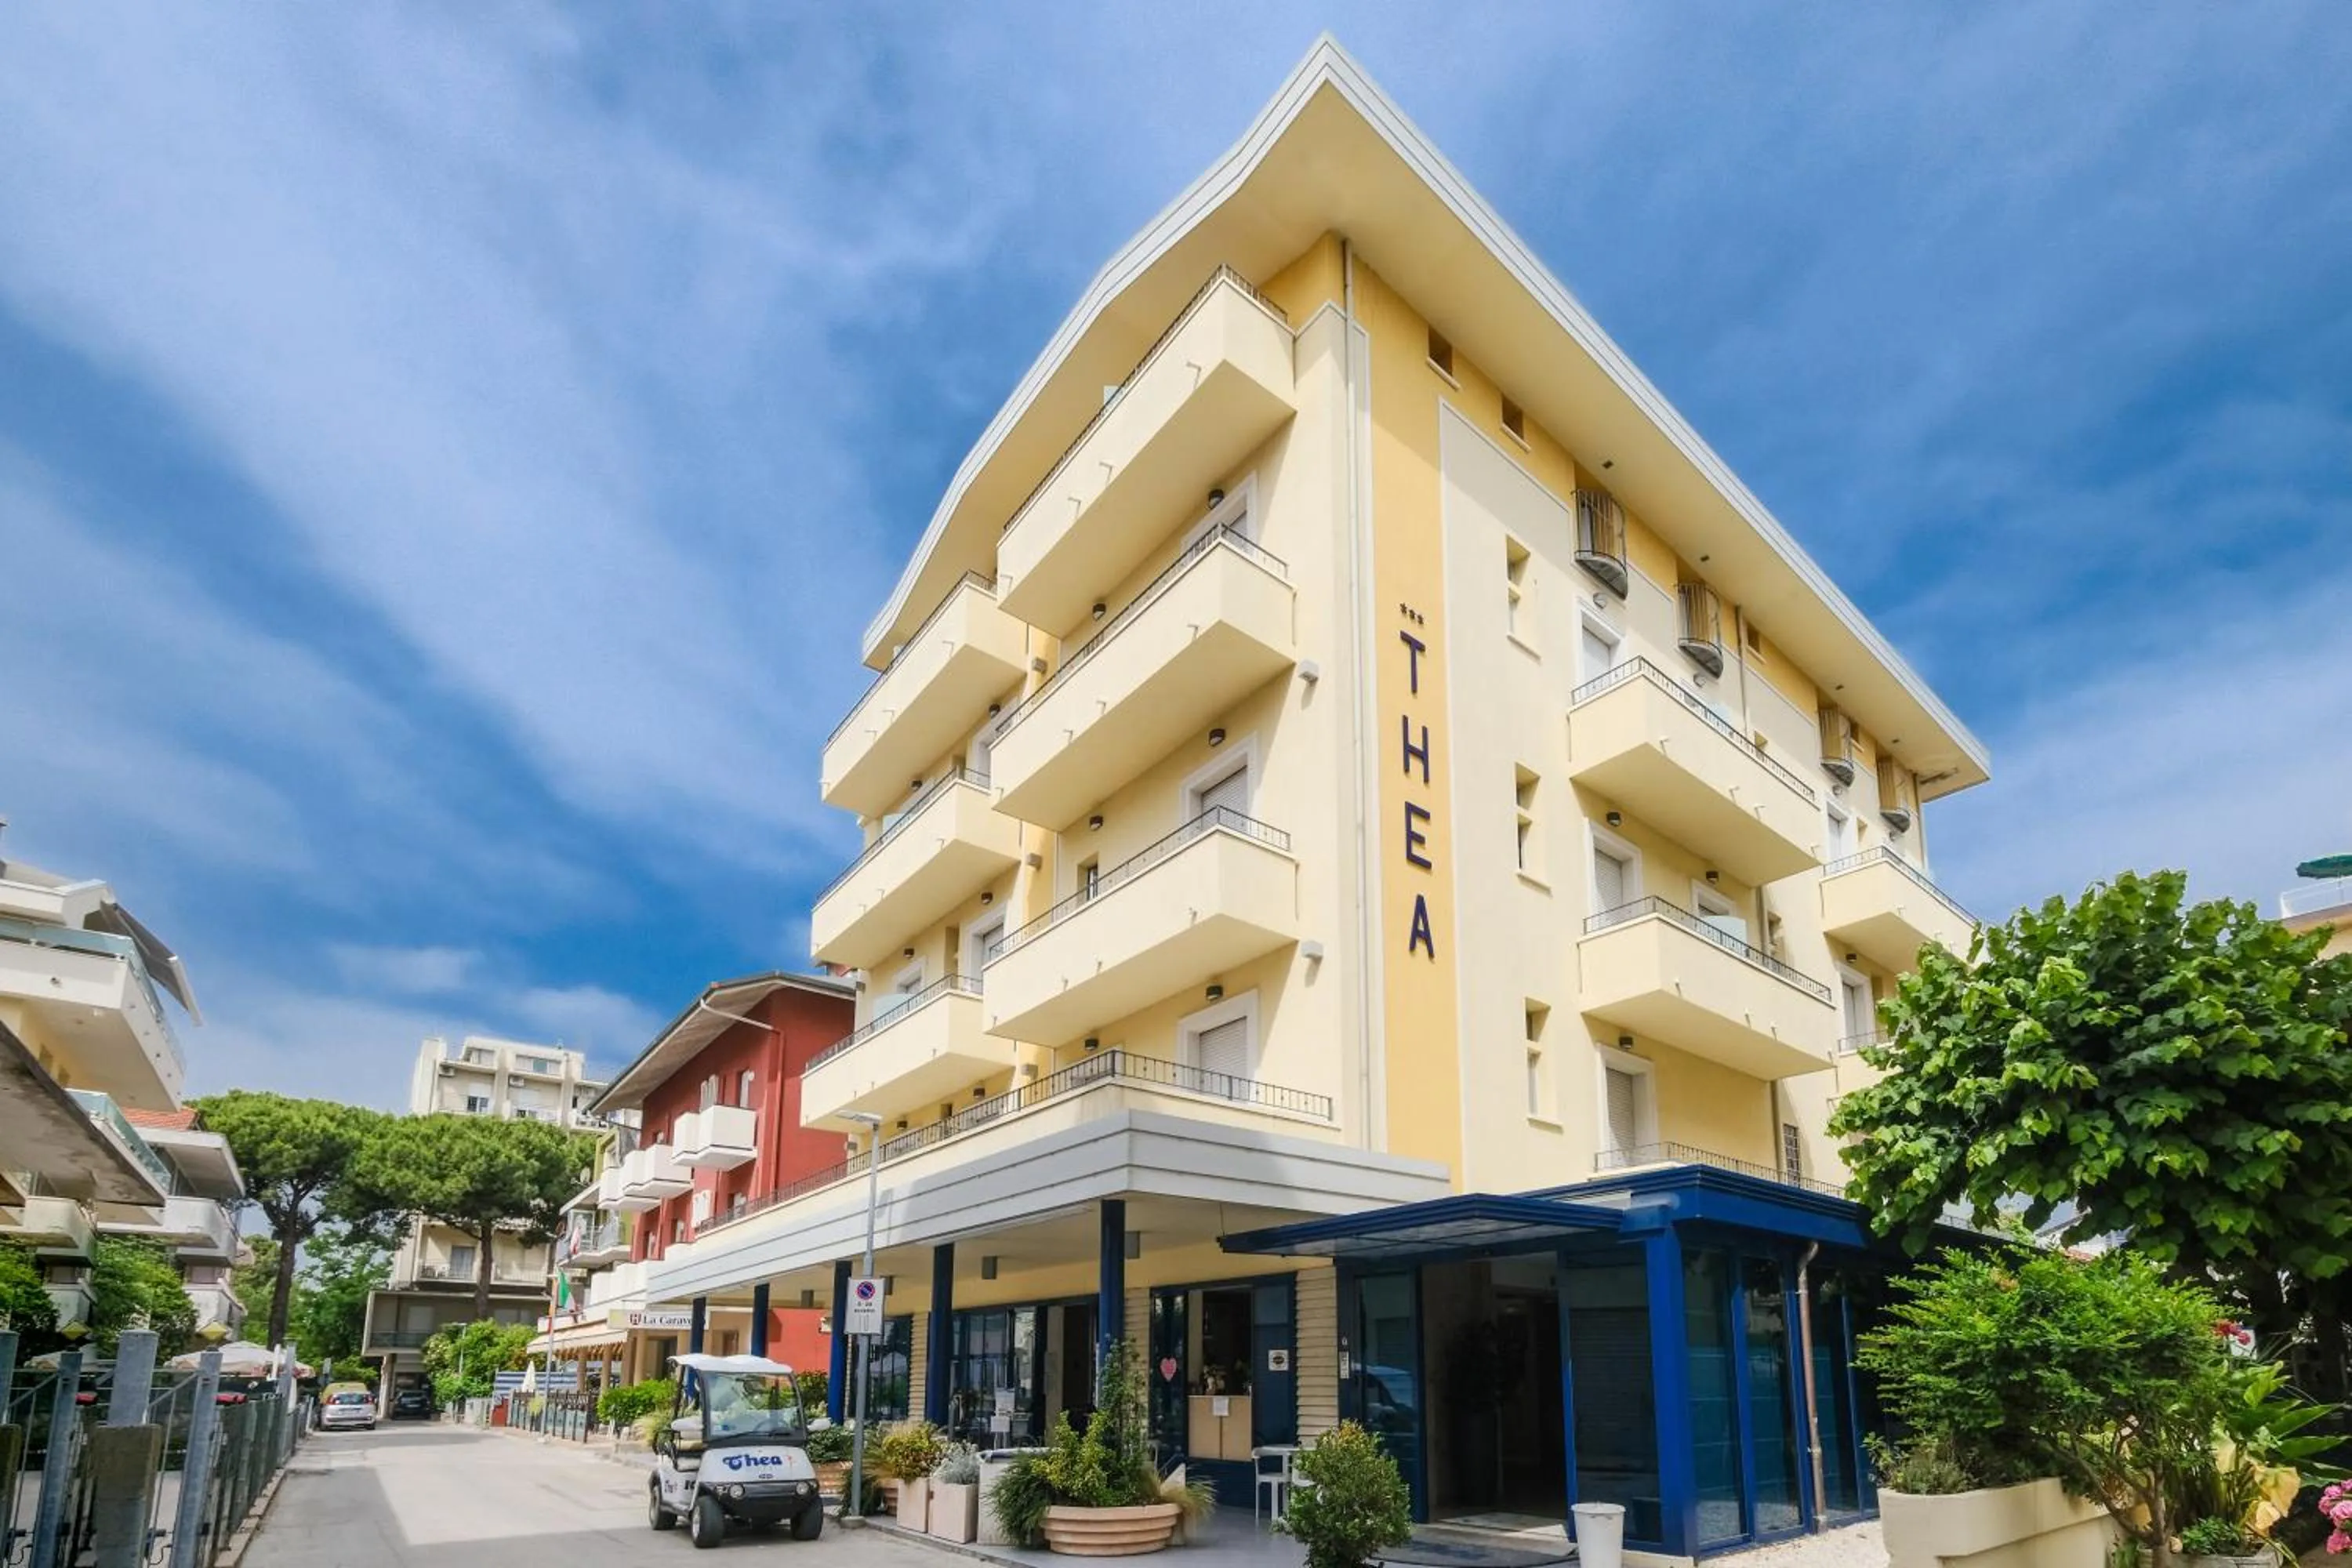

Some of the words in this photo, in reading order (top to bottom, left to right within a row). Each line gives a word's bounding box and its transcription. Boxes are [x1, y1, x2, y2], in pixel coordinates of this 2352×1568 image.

[1399, 630, 1435, 960] THEA
[643, 1315, 656, 1324] La
[722, 1454, 783, 1471] Thea
